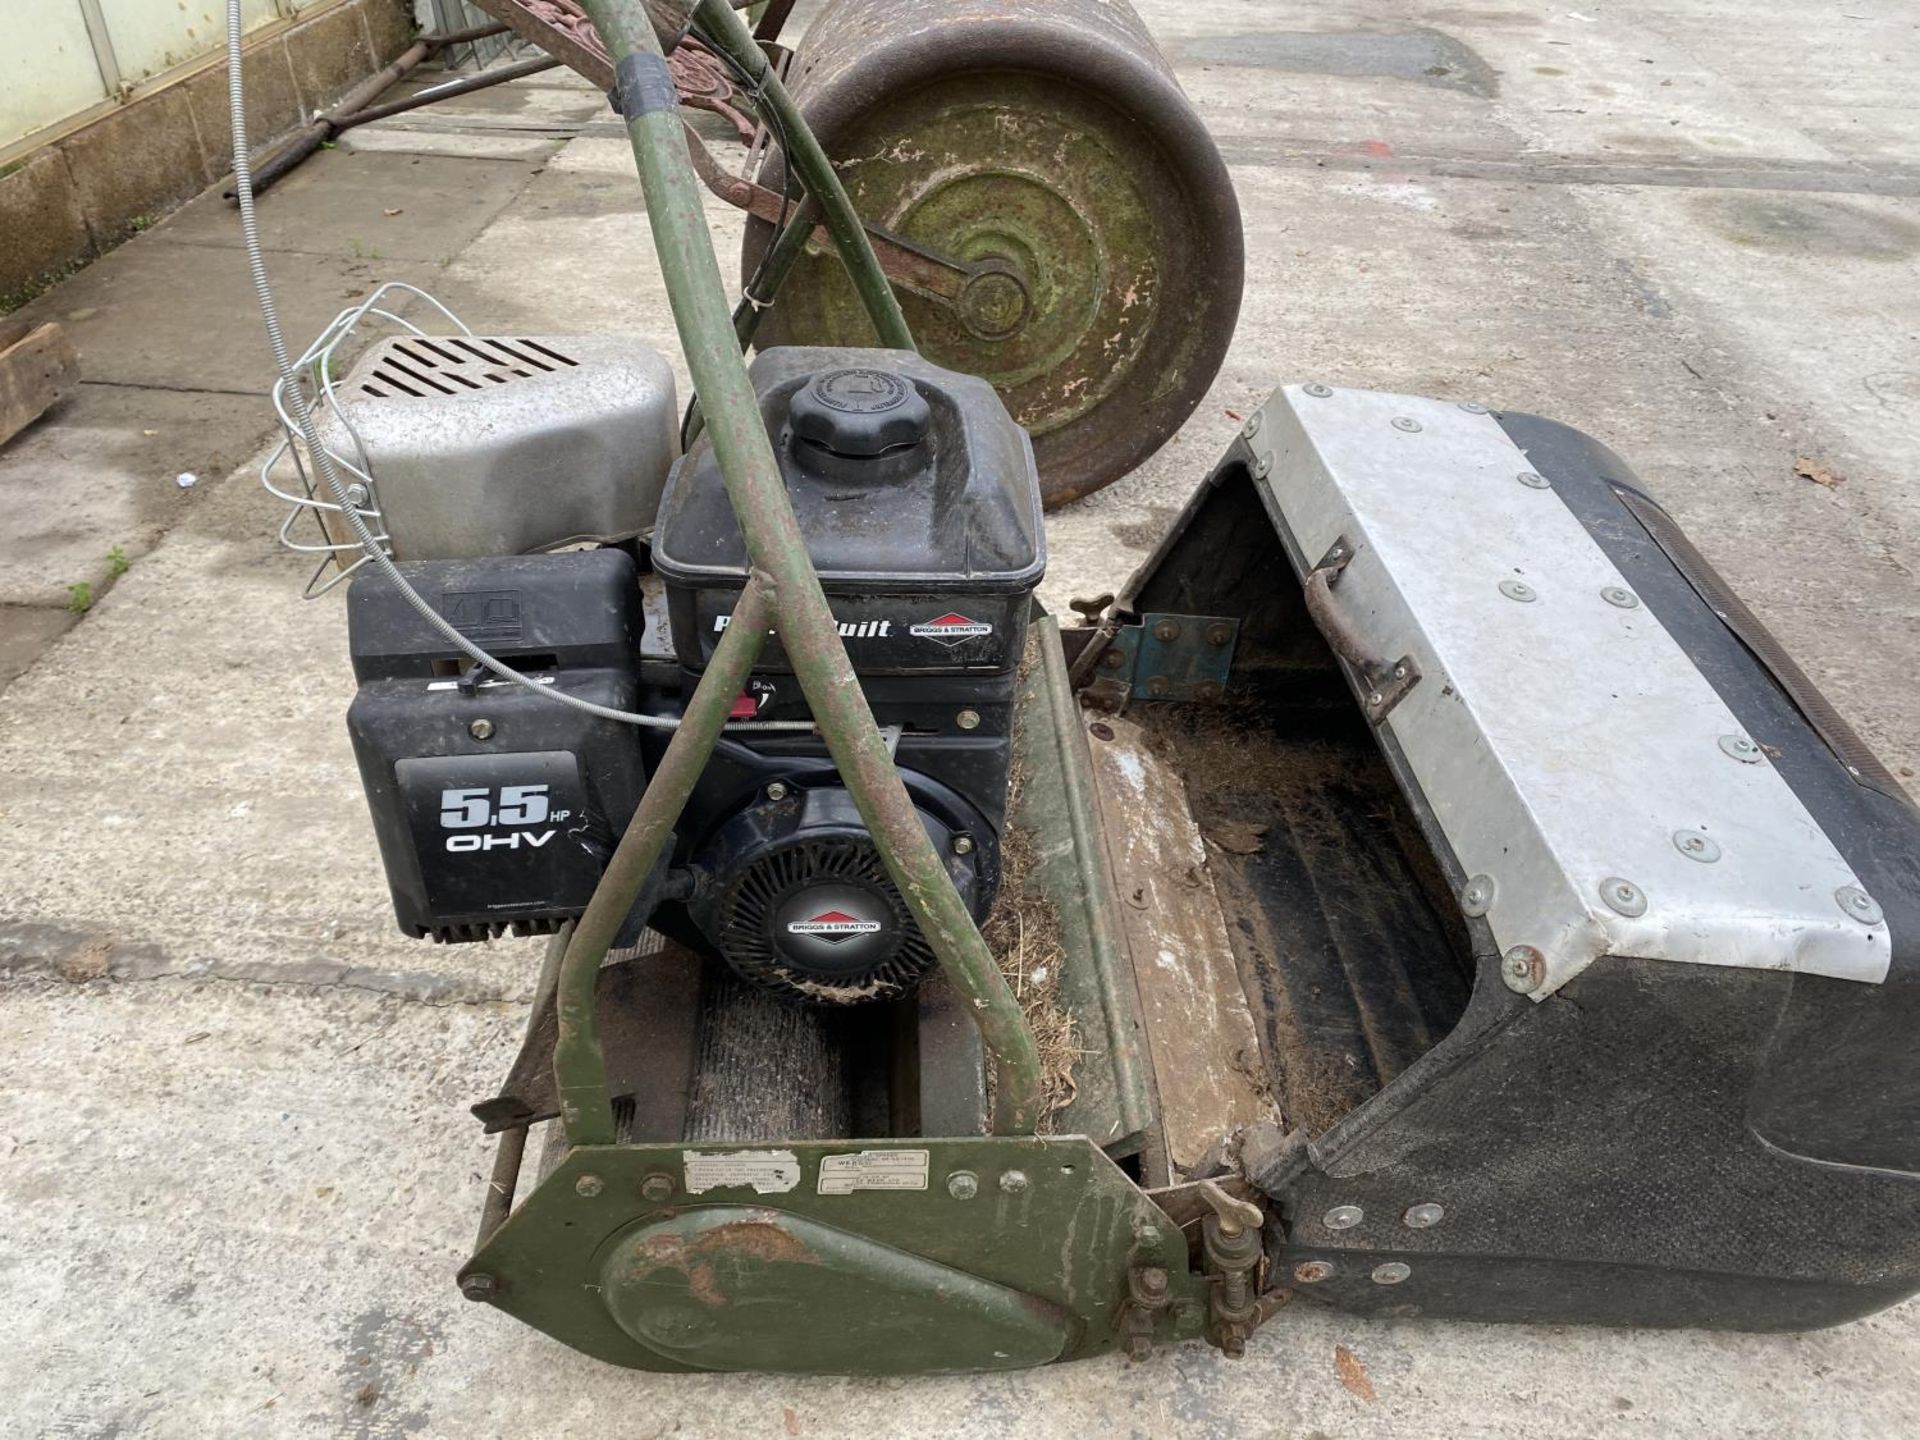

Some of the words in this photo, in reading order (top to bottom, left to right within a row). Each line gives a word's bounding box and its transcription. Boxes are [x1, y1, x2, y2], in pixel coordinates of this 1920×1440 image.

[440, 784, 549, 828] 5.5
[550, 810, 570, 823] HP
[446, 830, 556, 852] OHV
